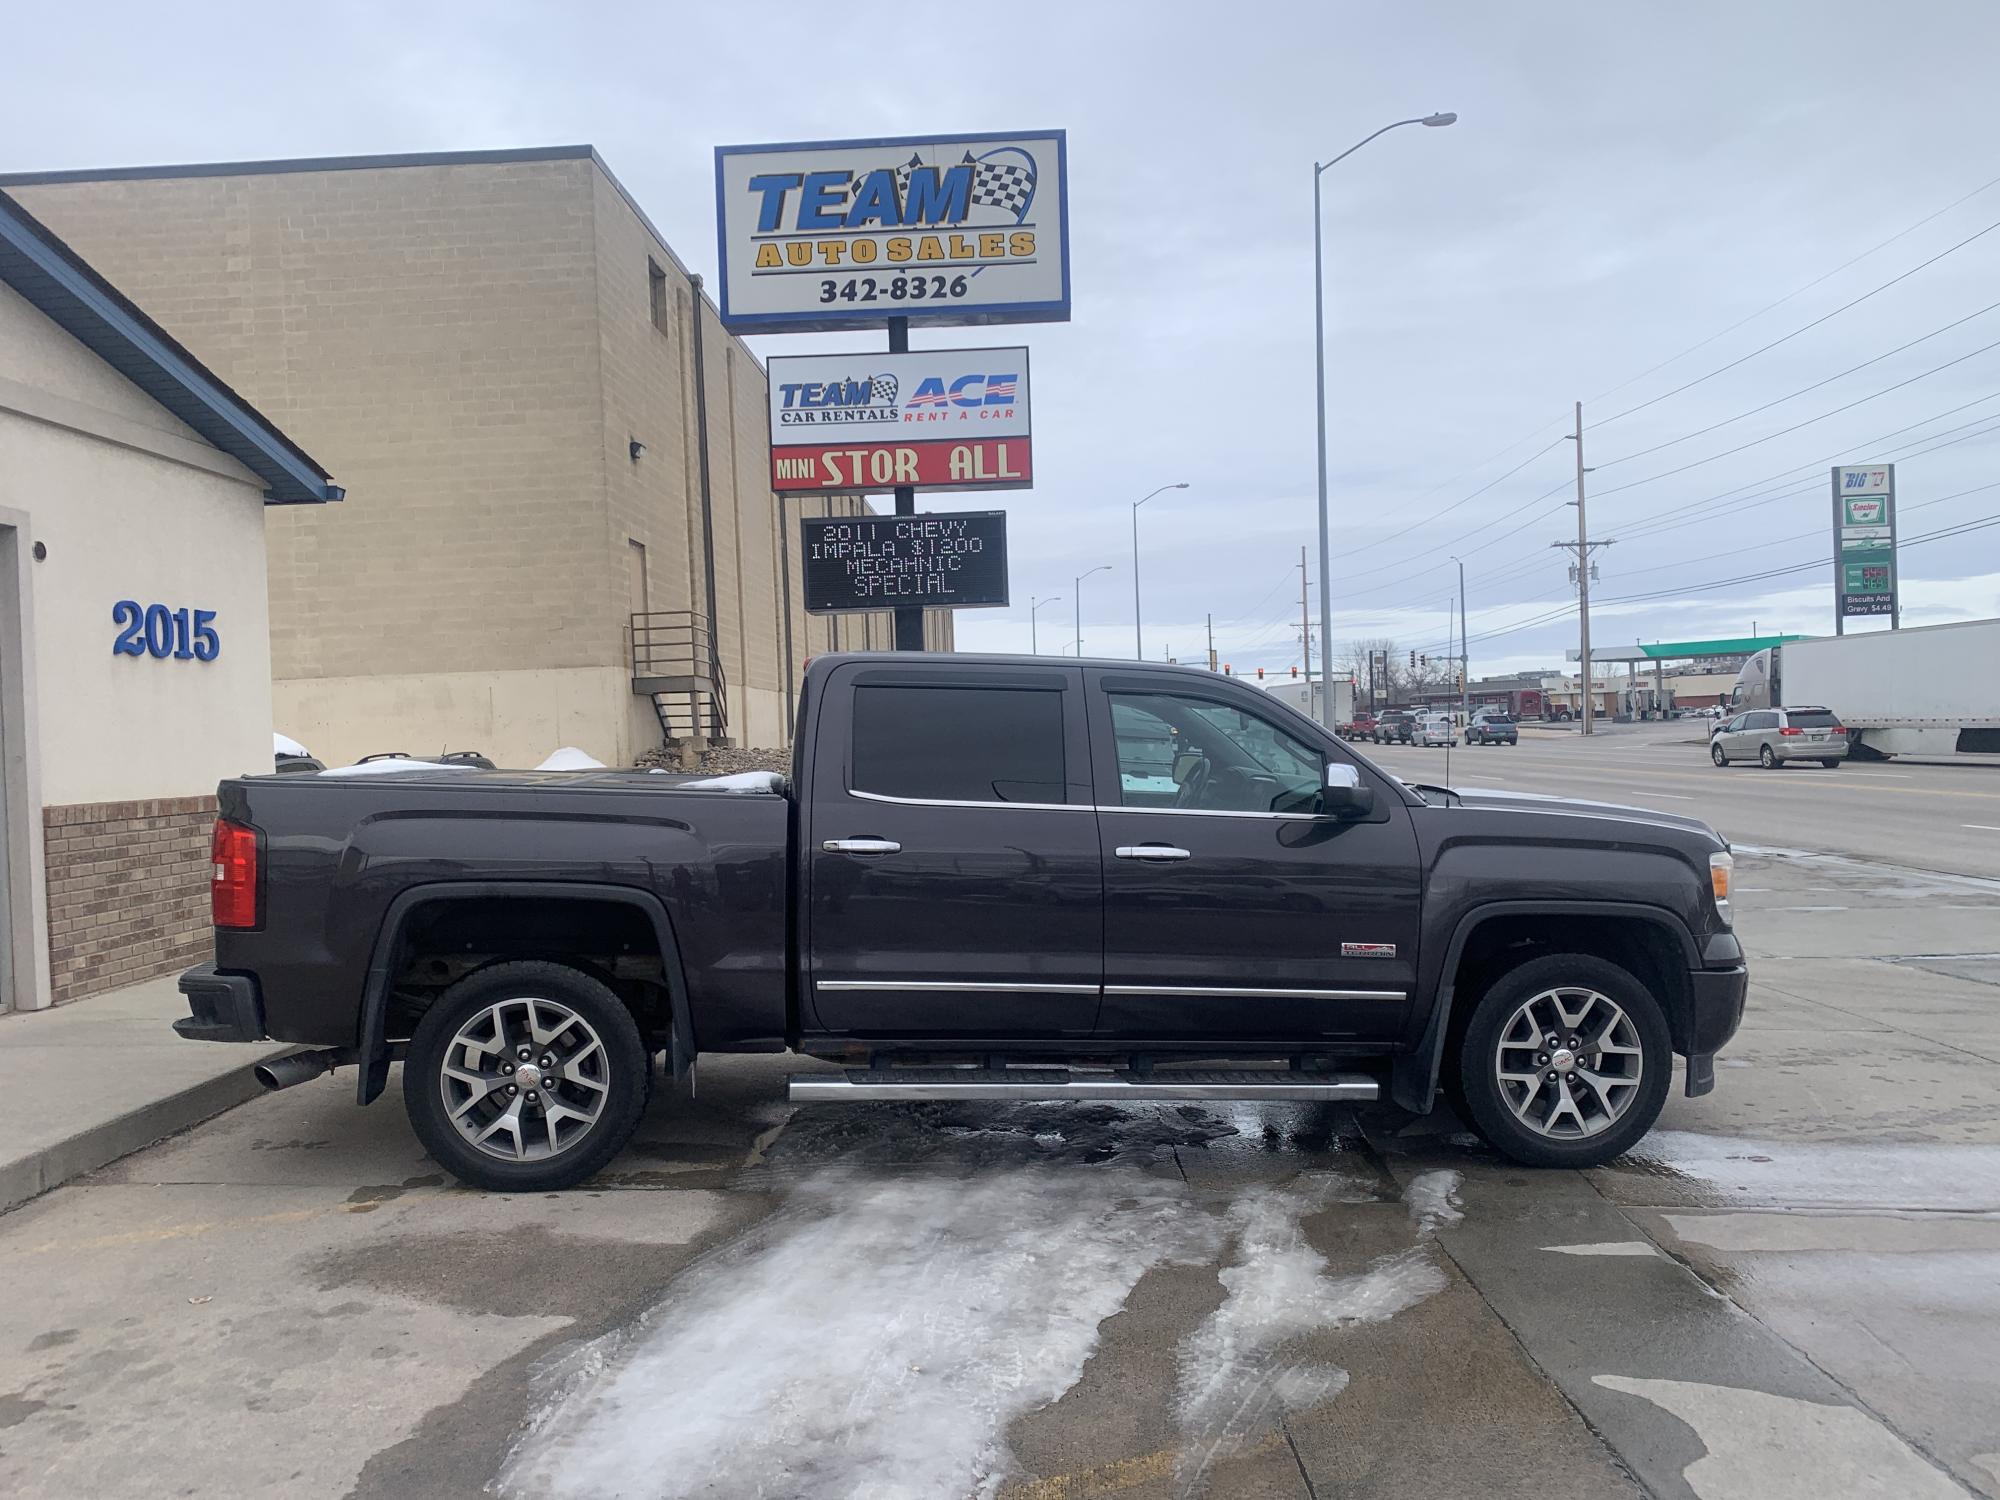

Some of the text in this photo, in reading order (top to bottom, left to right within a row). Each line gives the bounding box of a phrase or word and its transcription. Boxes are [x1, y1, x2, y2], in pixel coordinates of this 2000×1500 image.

[748, 164, 977, 233] TEAM
[819, 274, 968, 303] 342-8326
[778, 374, 1018, 408] TEAM ACE
[781, 408, 899, 423] CAR RENTALS
[904, 409, 1014, 422] RENT A CAR
[776, 443, 1021, 486] MINI STOR ALL
[1845, 472, 1868, 488] BIG
[1852, 503, 1879, 511] Sinclair
[823, 520, 967, 541] 2011 CHEVY
[812, 537, 983, 559] IMPALA $1200
[855, 573, 955, 596] SPECIAL
[1847, 596, 1874, 604] Biscuits
[1847, 605, 1868, 613] Gravy
[112, 600, 220, 662] 2015
